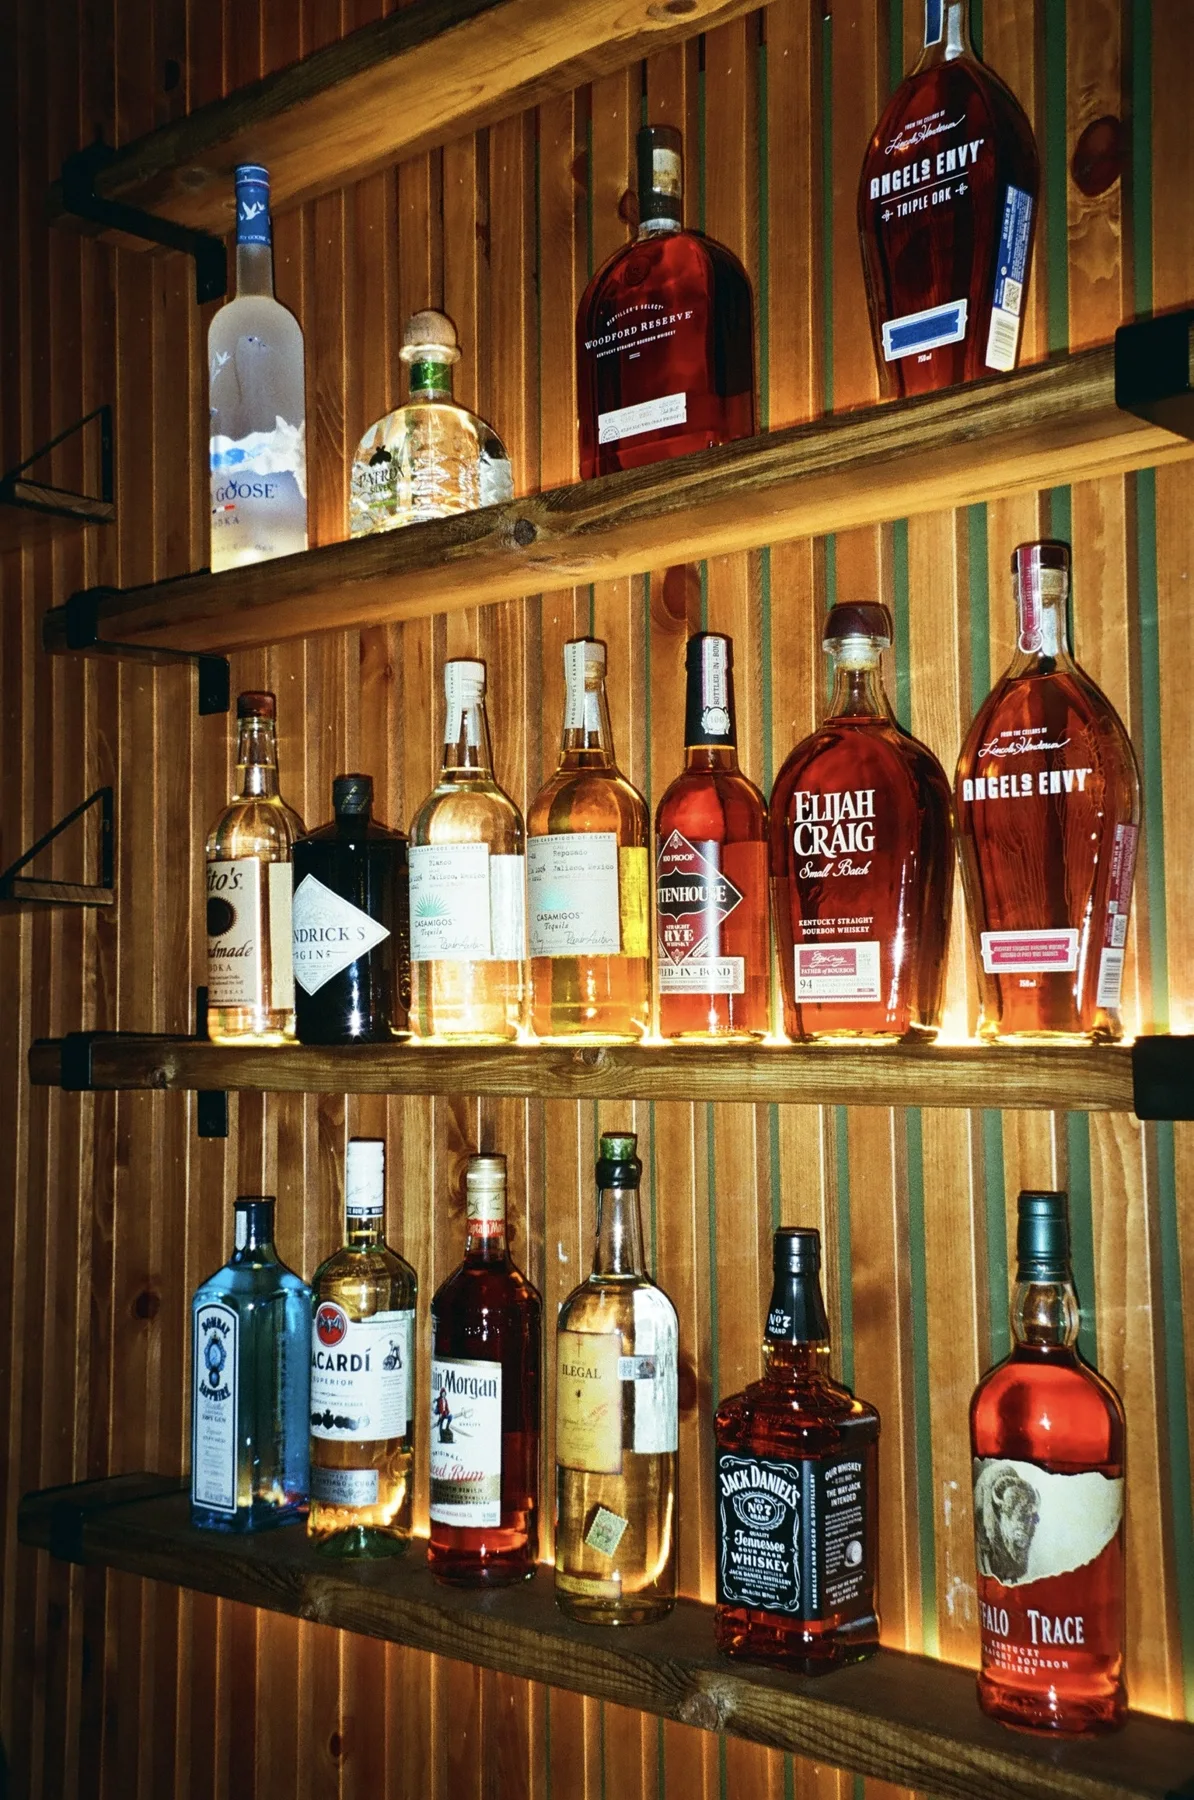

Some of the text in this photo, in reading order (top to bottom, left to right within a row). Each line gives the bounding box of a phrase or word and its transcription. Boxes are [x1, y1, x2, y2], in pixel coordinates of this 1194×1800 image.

[870, 139, 982, 200] ANGELS ENVY
[897, 186, 952, 218] TRIPLE OAK
[640, 303, 662, 311] SELECT
[584, 311, 692, 350] WOODFORD RESERVE
[216, 483, 275, 502] GOOSE
[963, 768, 1089, 802] ANGELS ENVY
[793, 789, 876, 827] ELIJAH
[793, 821, 876, 859] CRAIG
[671, 853, 695, 862] PROOF
[799, 858, 872, 879] Small Batch
[207, 867, 243, 891] ito's
[414, 919, 453, 928] CASAMIGOS
[536, 912, 580, 922] CASAMIGOS
[798, 917, 874, 927] KENTUCKY STRAIGHT
[420, 928, 443, 937] Tequila
[544, 922, 569, 932] Tequila
[664, 929, 694, 942] RYE
[802, 926, 870, 935] BOURBON WHISKEY
[799, 979, 813, 989] 94
[768, 1326, 787, 1334] BRAND
[312, 1348, 372, 1372] ACARDÍ
[562, 1363, 602, 1380] ILEGAL
[443, 1369, 498, 1400] Morgan
[448, 1464, 485, 1484] Rum
[825, 1462, 862, 1481] OUR WHISKEY
[719, 1465, 801, 1510] JACK DANIEL'S
[826, 1481, 862, 1498] THE WAY JACK
[830, 1492, 857, 1507] INTENDED
[749, 1513, 770, 1521] BRAND
[734, 1529, 786, 1553] Tennessee
[749, 1530, 770, 1539] QUALITY
[738, 1546, 782, 1559] SOUR MASH
[730, 1551, 790, 1573] WHISKEY
[743, 1571, 762, 1580] DANIEL
[762, 1575, 792, 1586] DISTILLERY
[980, 1602, 1085, 1645] FALO TRACE
[991, 1640, 1040, 1658] KENTUCKY
[994, 1659, 1037, 1676] WHISKEY
[1017, 1655, 1069, 1669] BOURBON
